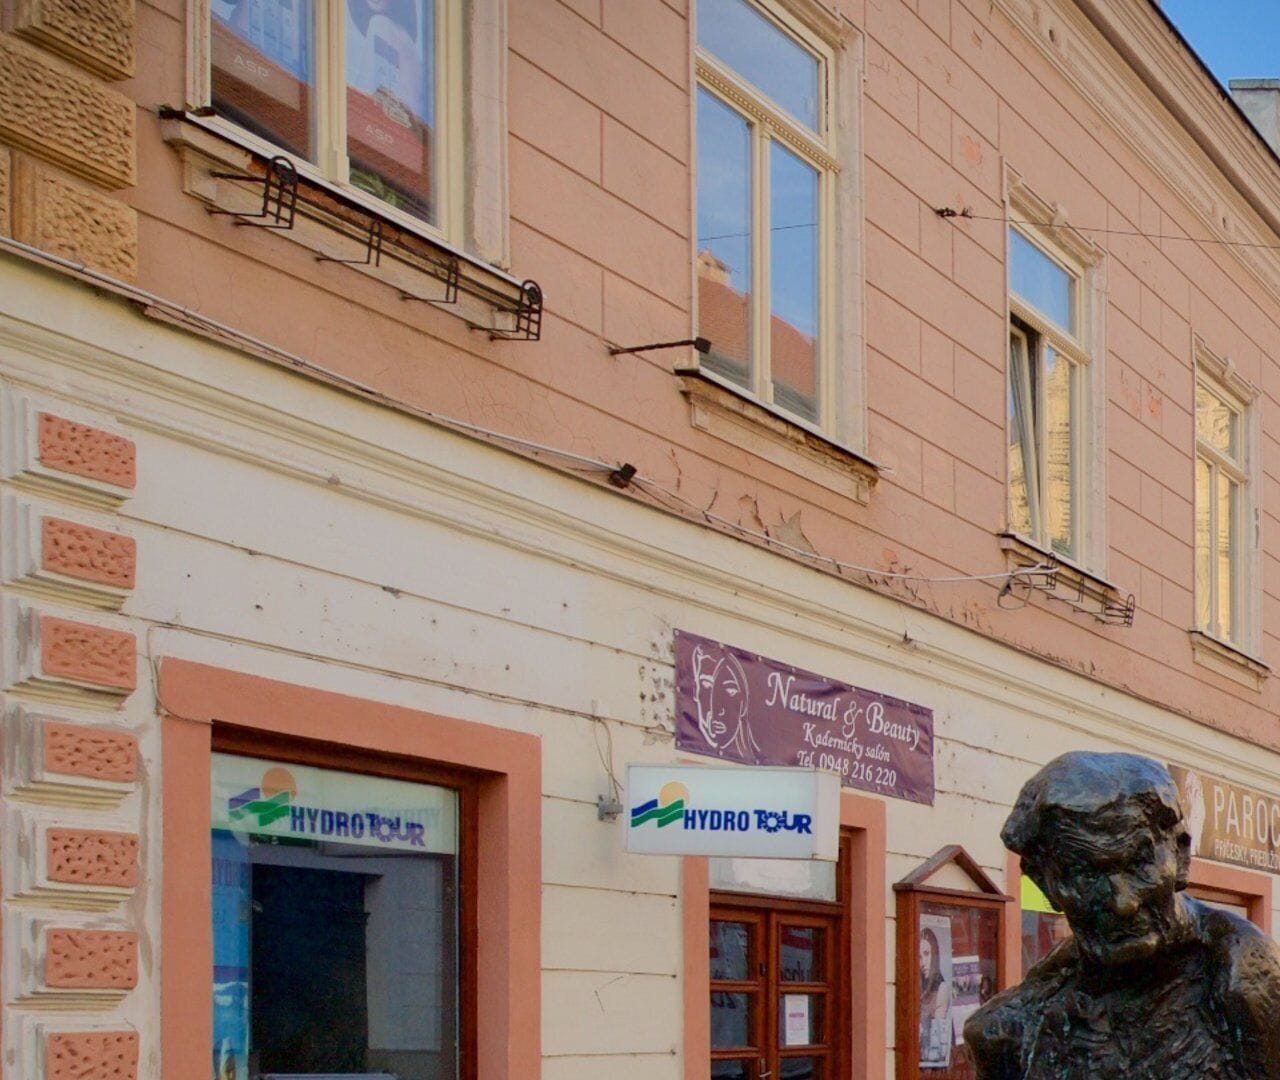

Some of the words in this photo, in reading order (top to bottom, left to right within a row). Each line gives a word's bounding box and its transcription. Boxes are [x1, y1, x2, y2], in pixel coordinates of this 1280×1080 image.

[765, 671, 841, 722] Natural
[842, 700, 863, 739] &
[865, 701, 920, 752] Beauty
[818, 752, 850, 777] 0948
[850, 760, 873, 783] 216
[874, 766, 898, 788] 220
[864, 742, 891, 763] salón
[291, 805, 364, 839] HYDRO
[365, 812, 426, 848] TOUR
[683, 808, 750, 832] HYDRO
[753, 809, 813, 835] TOUR
